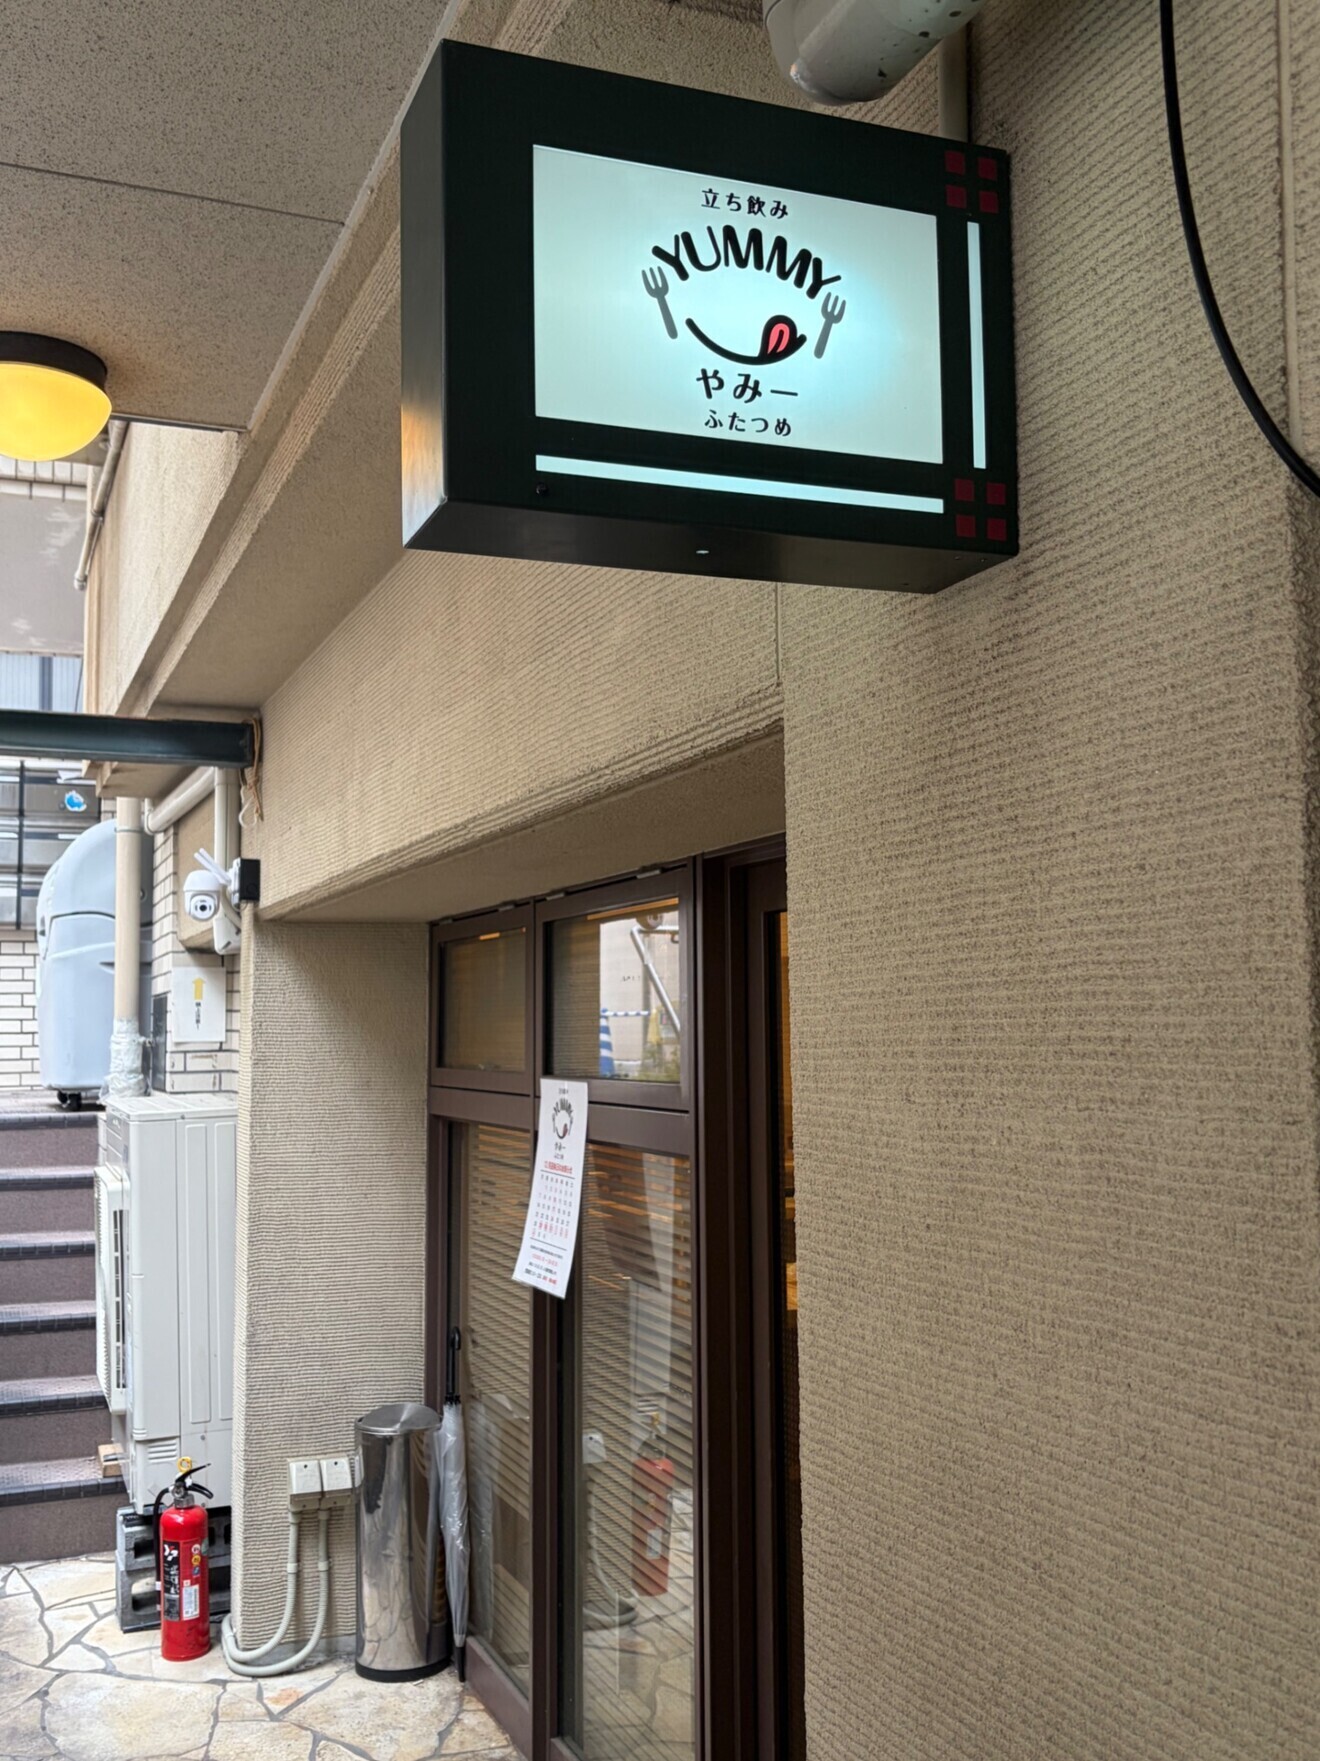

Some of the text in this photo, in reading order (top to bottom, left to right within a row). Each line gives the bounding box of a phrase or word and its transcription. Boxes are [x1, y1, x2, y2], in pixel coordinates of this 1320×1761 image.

[701, 188, 789, 219] 立ち飲み
[651, 224, 842, 300] YUMMY
[696, 367, 799, 404] やみー
[704, 409, 792, 437] ふたつめ
